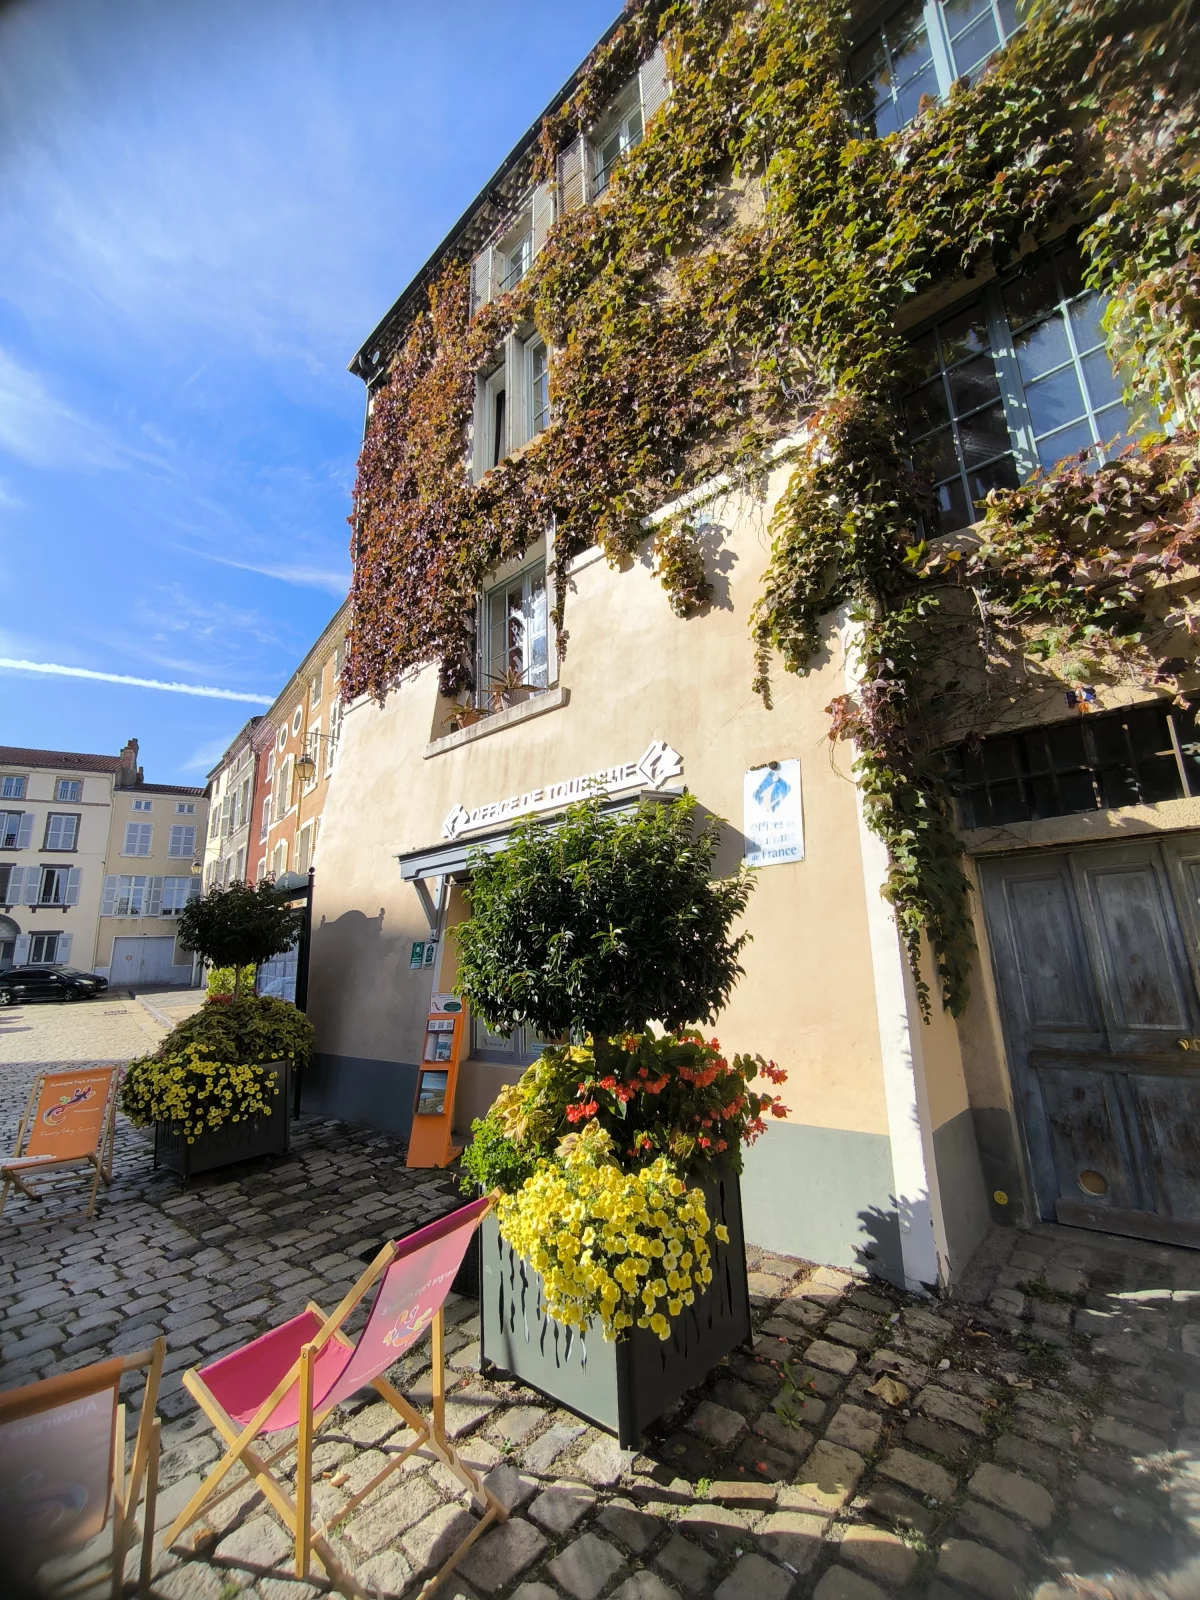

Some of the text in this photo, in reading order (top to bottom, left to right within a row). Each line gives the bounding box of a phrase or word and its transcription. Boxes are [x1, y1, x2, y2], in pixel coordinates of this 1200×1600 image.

[470, 795, 521, 822] OFFICE
[521, 788, 545, 810] DE
[751, 846, 797, 861] de France
